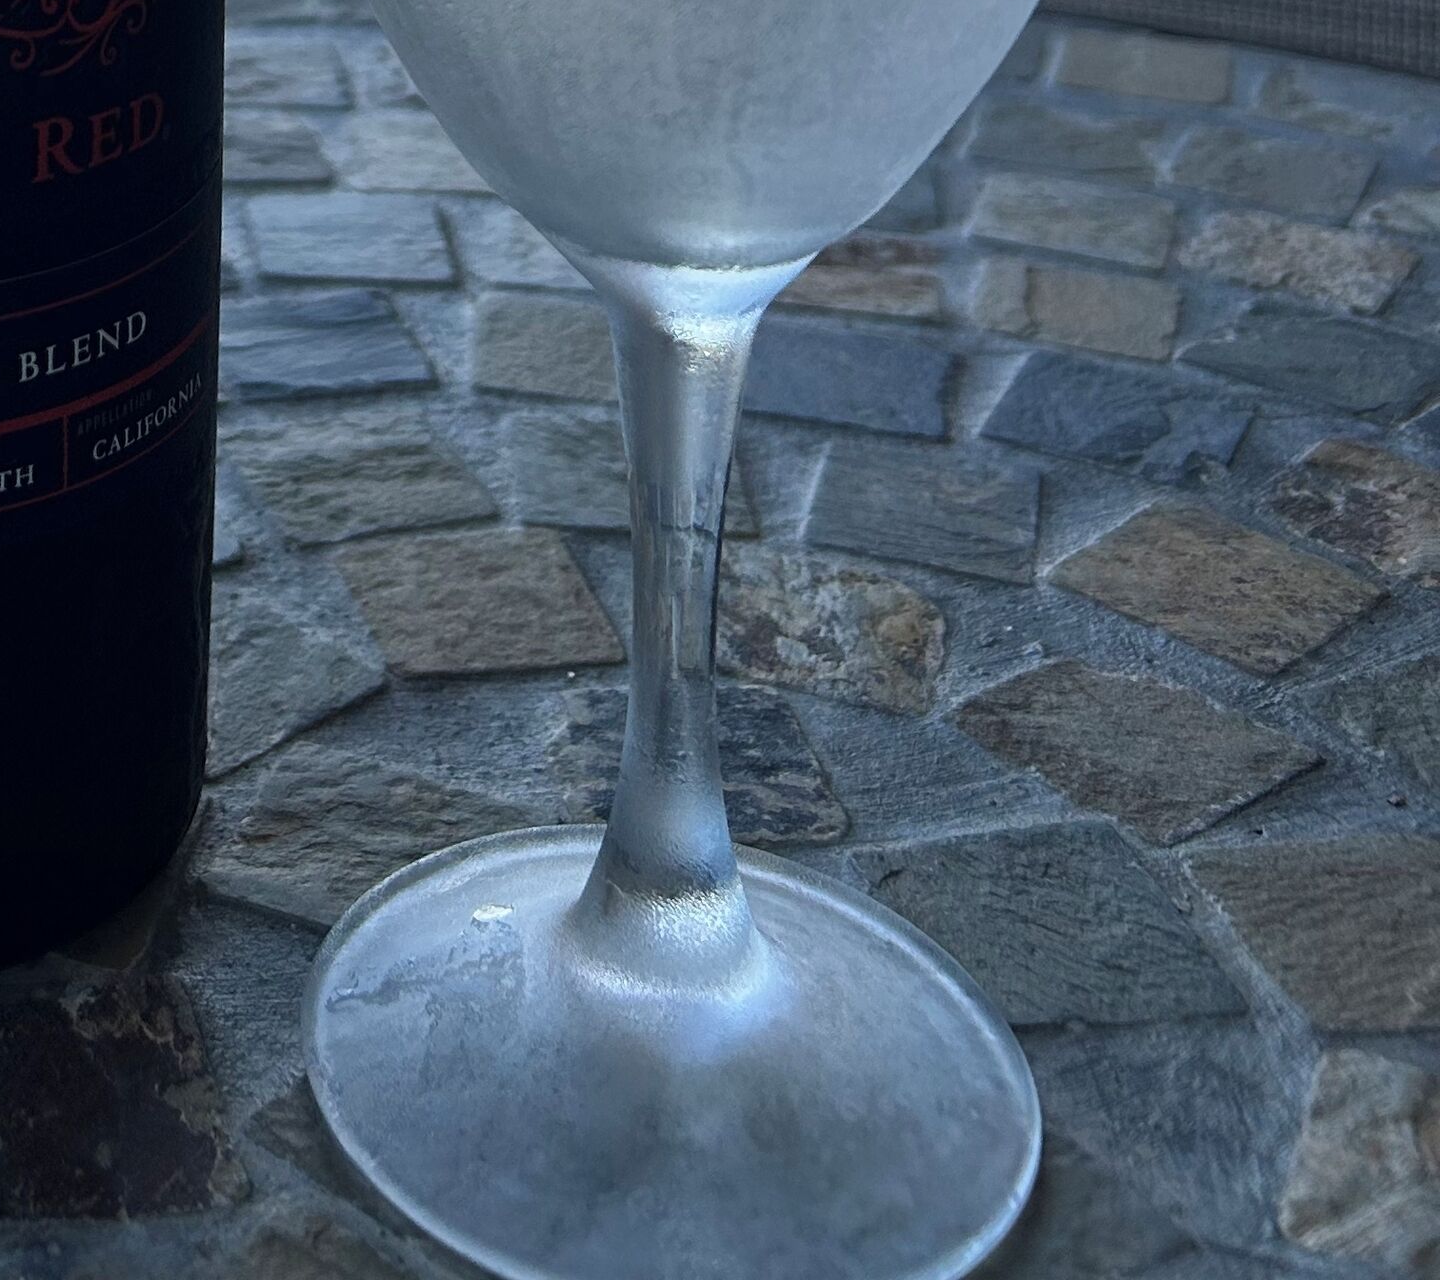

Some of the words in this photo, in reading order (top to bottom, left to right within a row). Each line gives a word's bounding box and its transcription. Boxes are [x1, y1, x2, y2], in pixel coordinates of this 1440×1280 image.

[31, 92, 164, 185] RED
[17, 309, 149, 384] BLEND
[91, 371, 202, 462] CALIFORNIA
